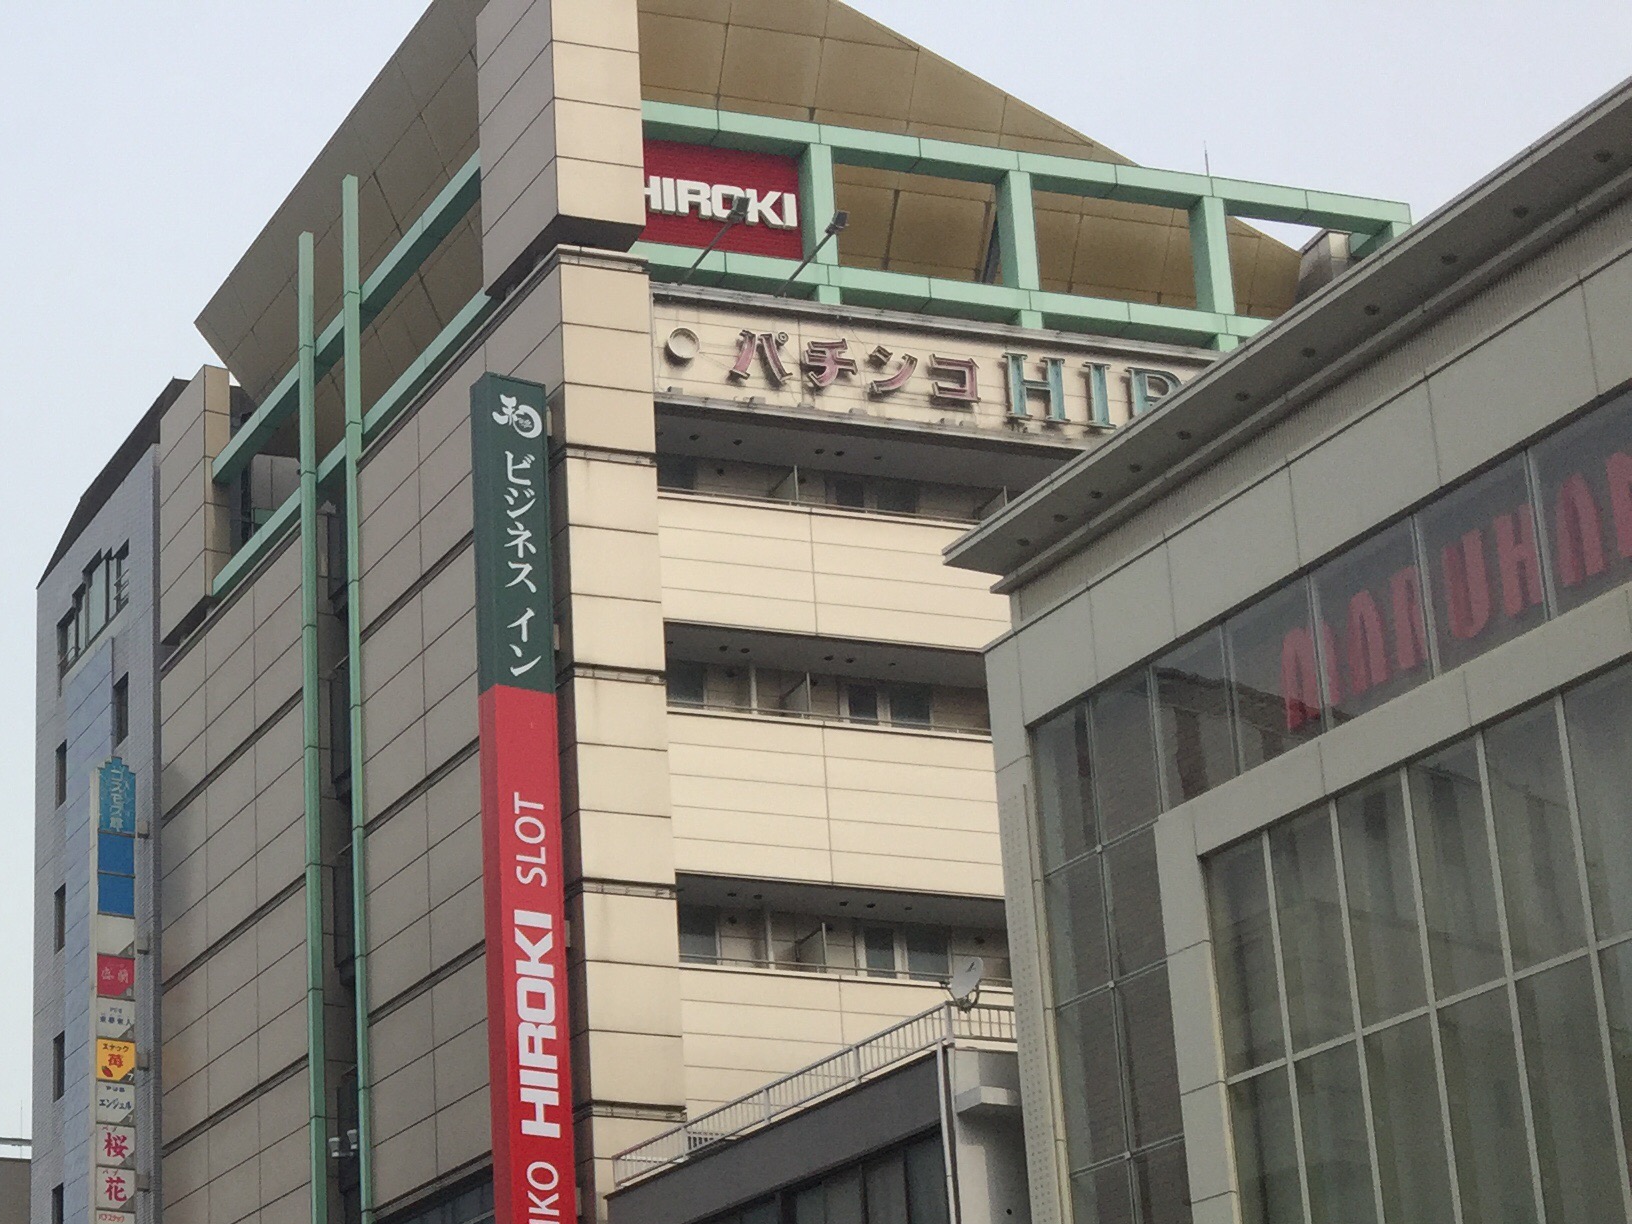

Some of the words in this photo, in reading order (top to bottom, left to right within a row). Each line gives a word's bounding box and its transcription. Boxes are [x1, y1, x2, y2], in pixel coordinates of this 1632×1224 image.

[643, 176, 798, 229] HIROKI
[730, 328, 981, 403] パチンコ
[514, 792, 547, 887] SLOT
[102, 1043, 129, 1053] スナック
[514, 909, 561, 1138] HIROKI
[104, 1132, 129, 1159] 桜
[105, 1176, 128, 1203] 花
